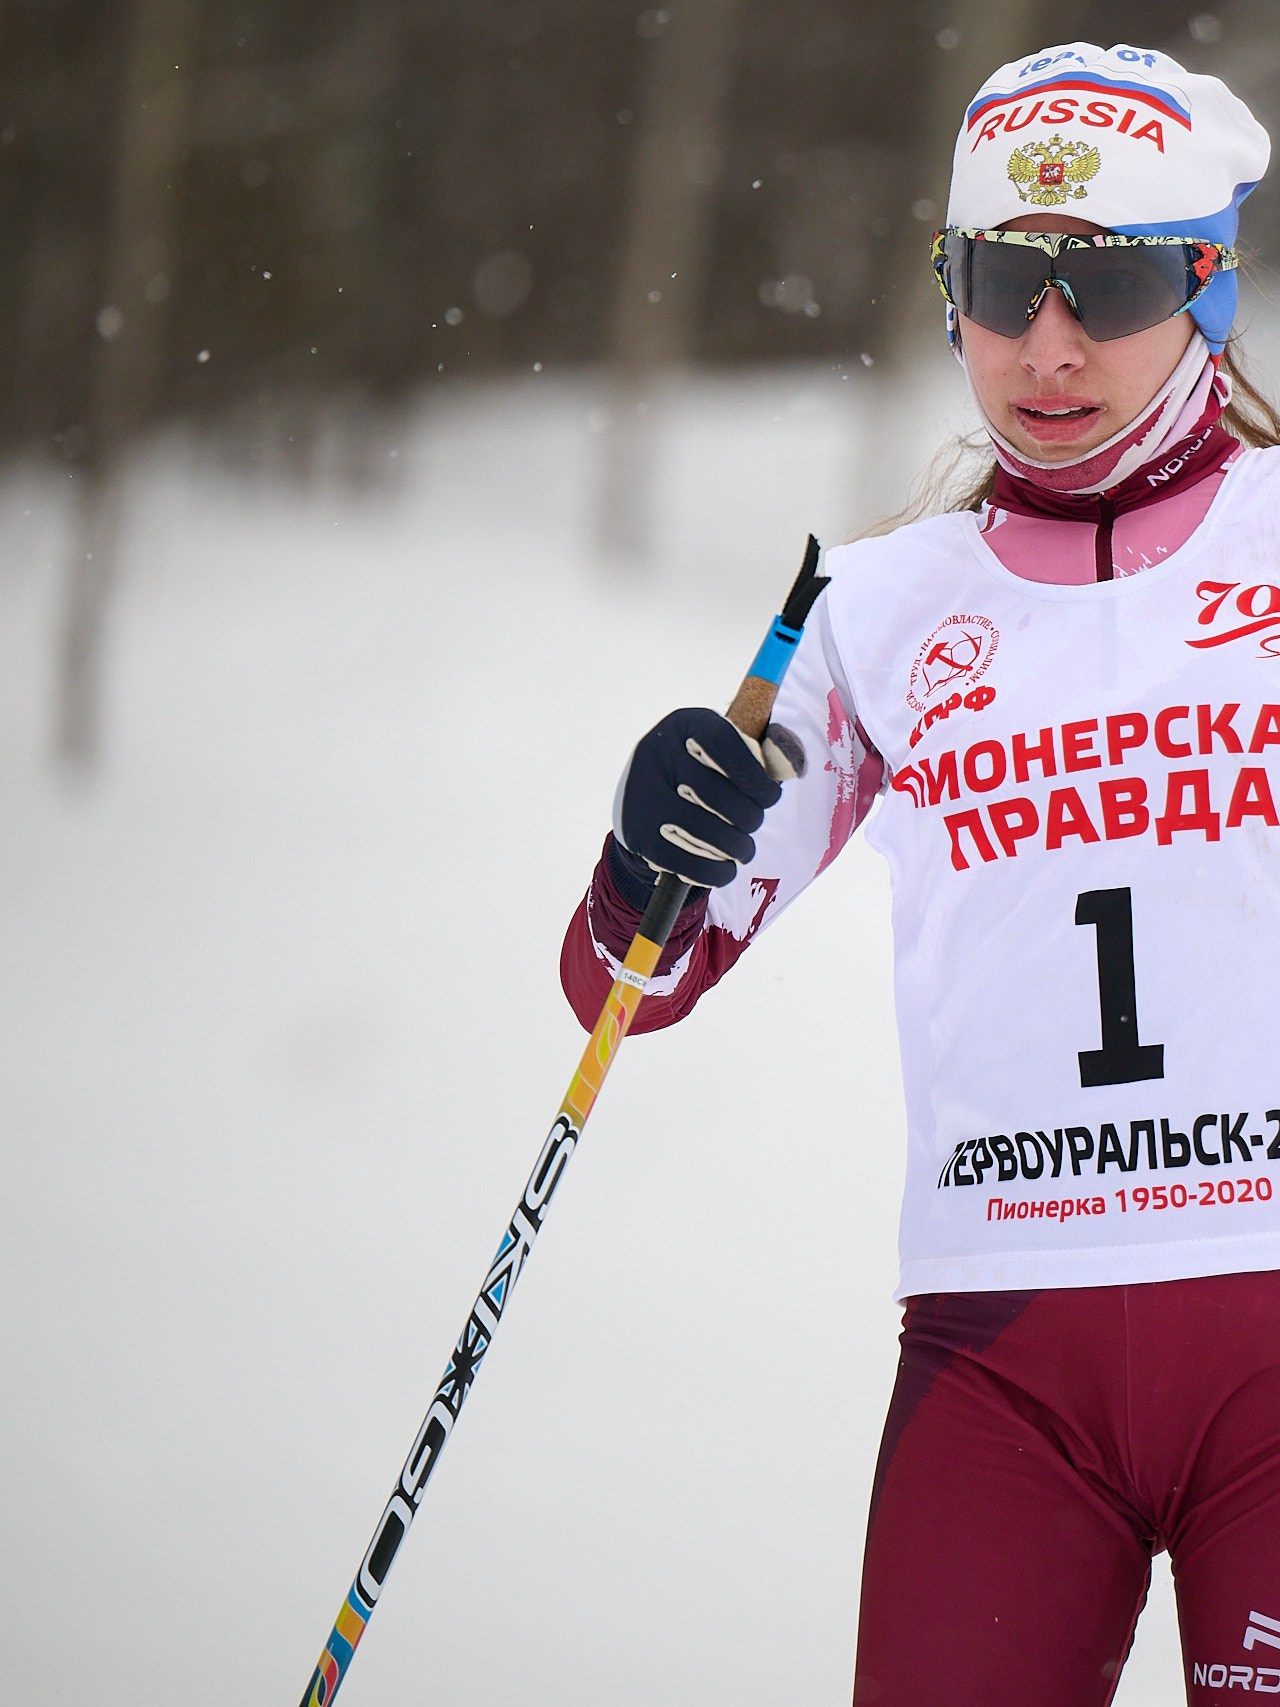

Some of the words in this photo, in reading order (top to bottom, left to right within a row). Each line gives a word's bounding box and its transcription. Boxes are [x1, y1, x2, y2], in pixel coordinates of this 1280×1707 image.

[1116, 50, 1156, 68] of
[970, 98, 1165, 154] RUSSIA
[910, 658, 922, 686] ТРУД
[943, 767, 1280, 872] ПРАВДА
[1075, 887, 1164, 1088] 1
[987, 1196, 1106, 1223] Пионерка
[1115, 1177, 1273, 1212] 1950-2020
